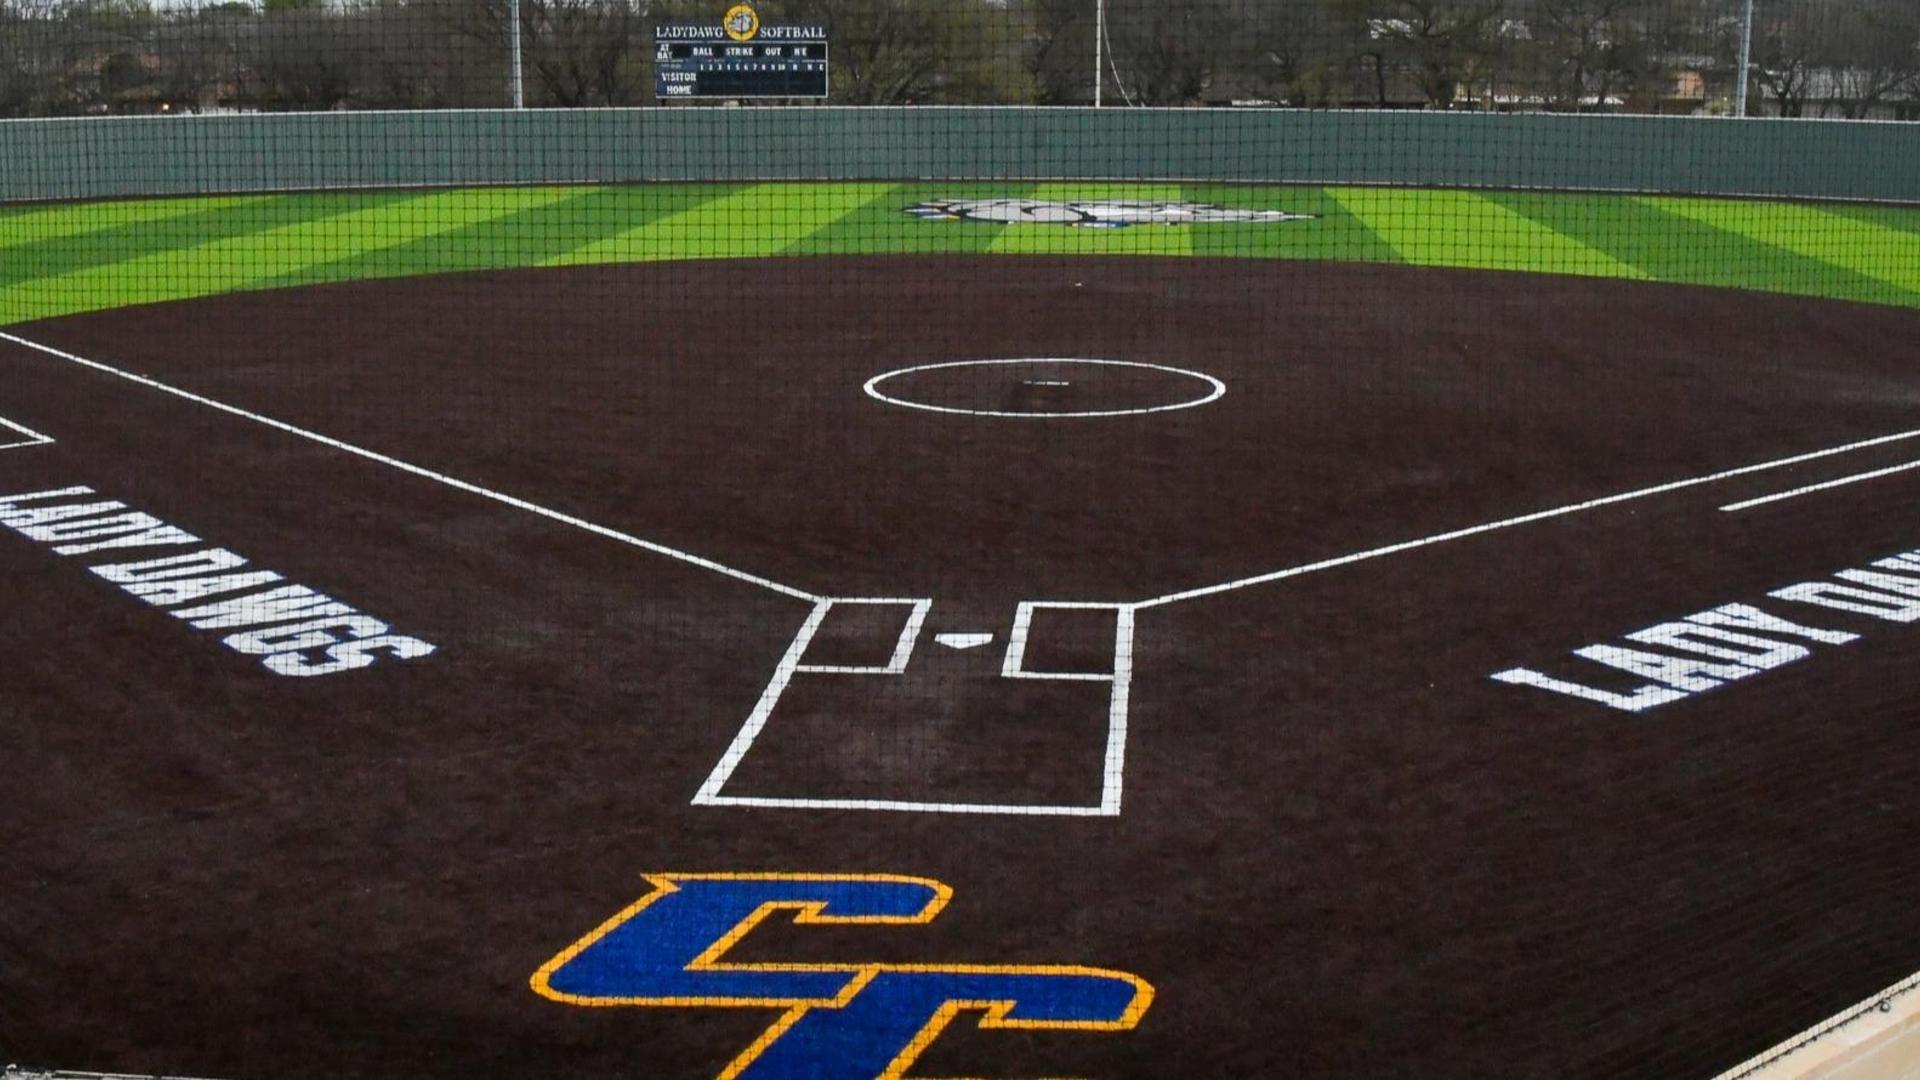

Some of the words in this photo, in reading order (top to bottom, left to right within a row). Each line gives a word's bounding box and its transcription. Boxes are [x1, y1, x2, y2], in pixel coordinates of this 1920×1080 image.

[760, 26, 827, 38] SOFTBALL
[693, 47, 713, 56] BALL
[765, 47, 781, 56] OUT
[661, 72, 697, 81] VISITOR
[666, 85, 691, 95] HOME
[88, 548, 437, 677] DAWGS
[1489, 603, 1861, 712] LADY
